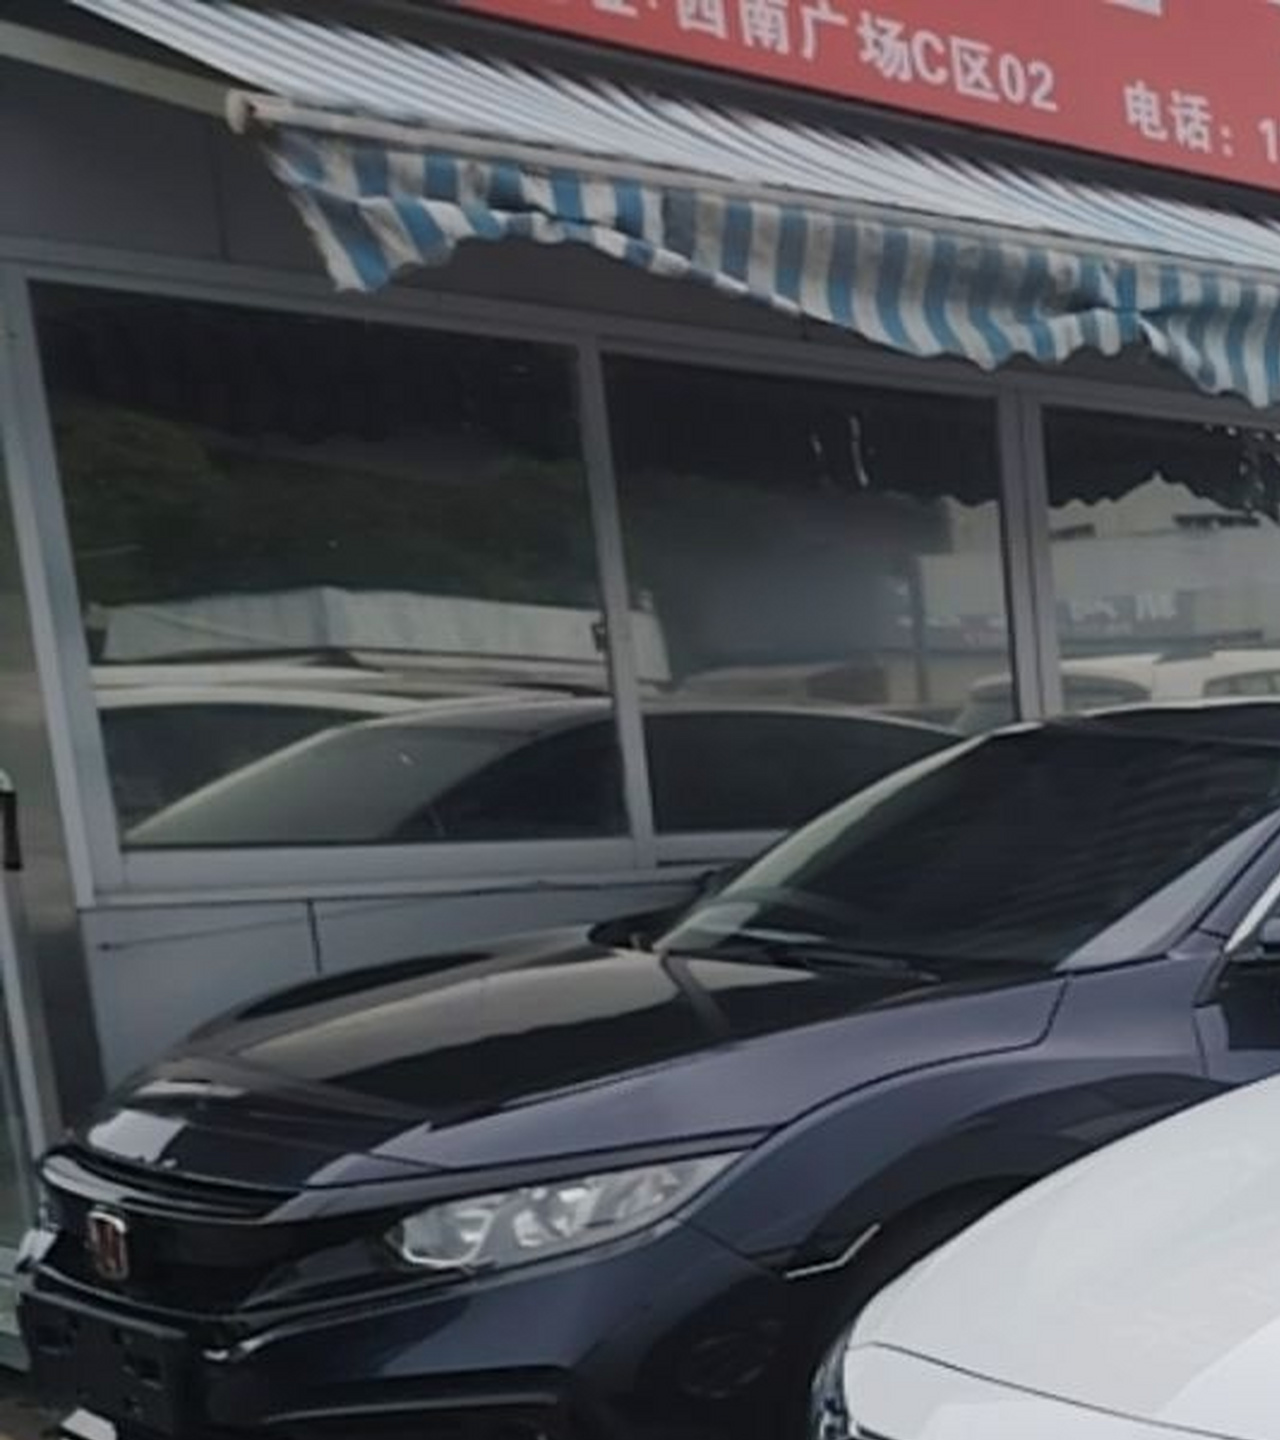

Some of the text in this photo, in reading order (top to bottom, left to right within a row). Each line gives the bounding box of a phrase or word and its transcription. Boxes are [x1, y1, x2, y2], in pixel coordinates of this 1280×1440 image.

[592, 0, 1059, 112] 西南广场C区02
